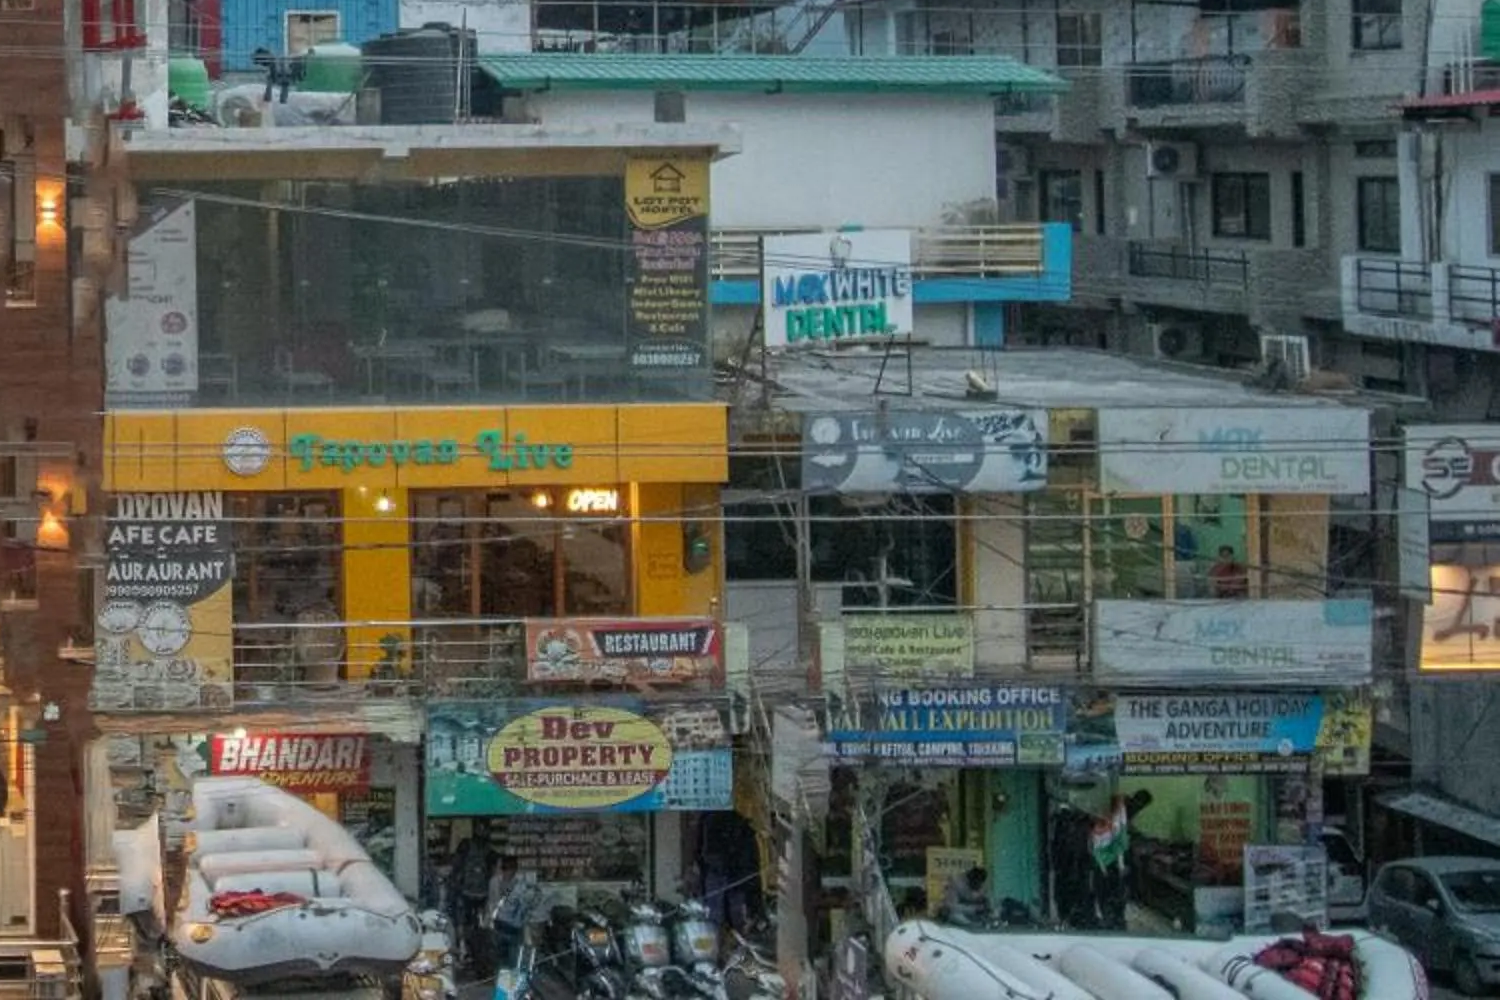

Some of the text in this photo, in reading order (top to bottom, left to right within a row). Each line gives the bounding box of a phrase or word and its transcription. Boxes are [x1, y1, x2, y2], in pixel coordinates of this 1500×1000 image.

[786, 301, 898, 343] DENTAL
[290, 428, 574, 472] Tapovan Live
[1220, 456, 1337, 480] DENTAL
[567, 490, 618, 510] OPEN
[605, 633, 699, 653] RESTAURANT
[908, 688, 993, 706] BOOKING
[997, 686, 1062, 704] OFFICE
[1129, 700, 1311, 718] THE GANGA HOLIDAY
[540, 716, 616, 741] Dev
[1165, 720, 1271, 739] ADVENTURE
[219, 737, 365, 771] BHANDARI
[503, 744, 655, 767] PROPERTY
